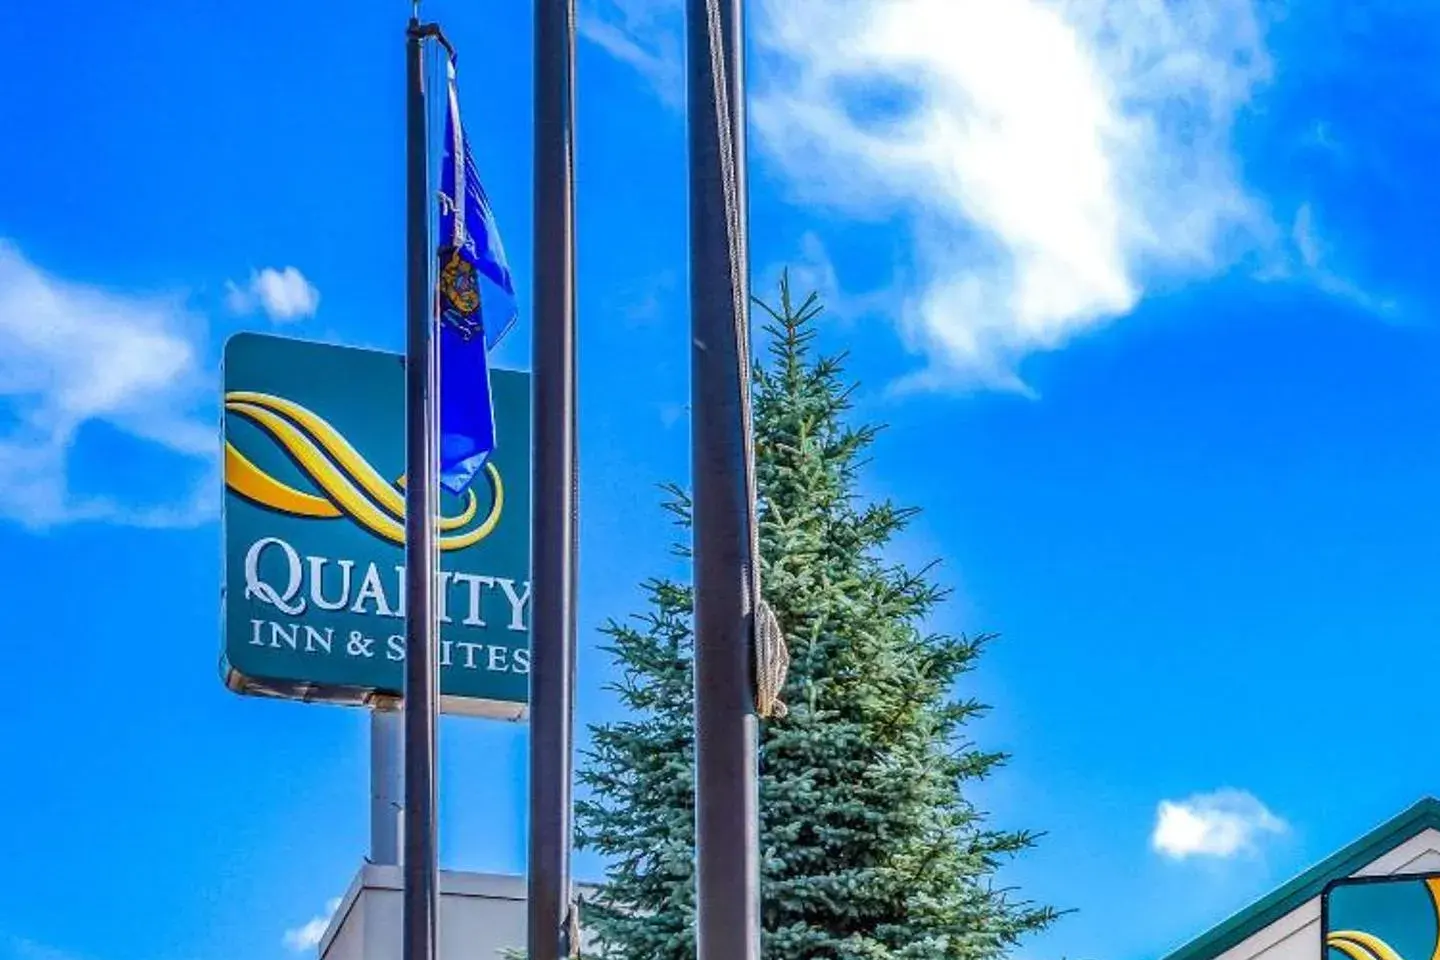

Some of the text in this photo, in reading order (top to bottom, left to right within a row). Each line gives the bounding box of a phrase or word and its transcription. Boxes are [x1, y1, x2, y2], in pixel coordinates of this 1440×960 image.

[250, 620, 530, 673] INN & SITES
